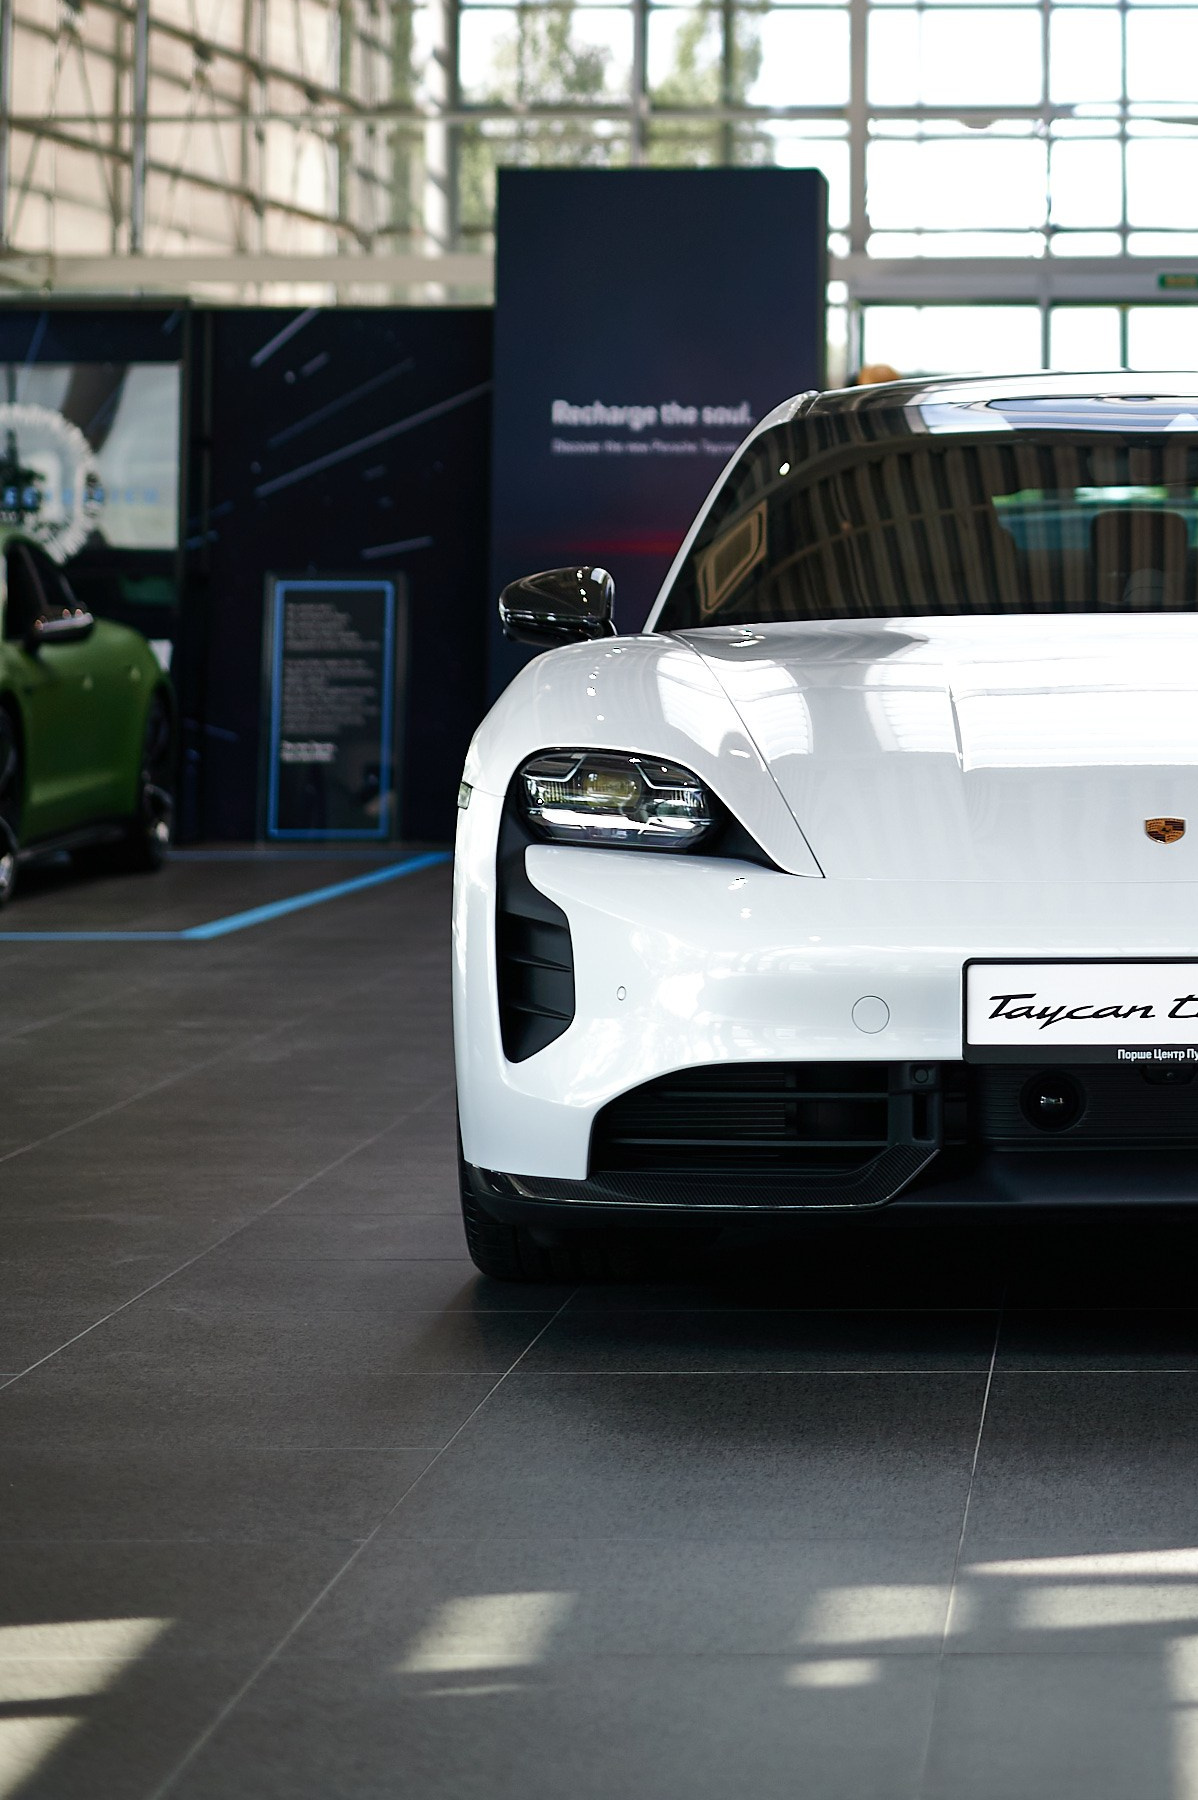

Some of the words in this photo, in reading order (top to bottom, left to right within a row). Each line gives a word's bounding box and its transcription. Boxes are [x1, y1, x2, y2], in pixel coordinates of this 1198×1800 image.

[552, 399, 657, 431] Recharge
[660, 401, 697, 425] the
[988, 993, 1156, 1030] Taycan
[1117, 1049, 1152, 1061] Порше
[1153, 1049, 1185, 1061] Центр
